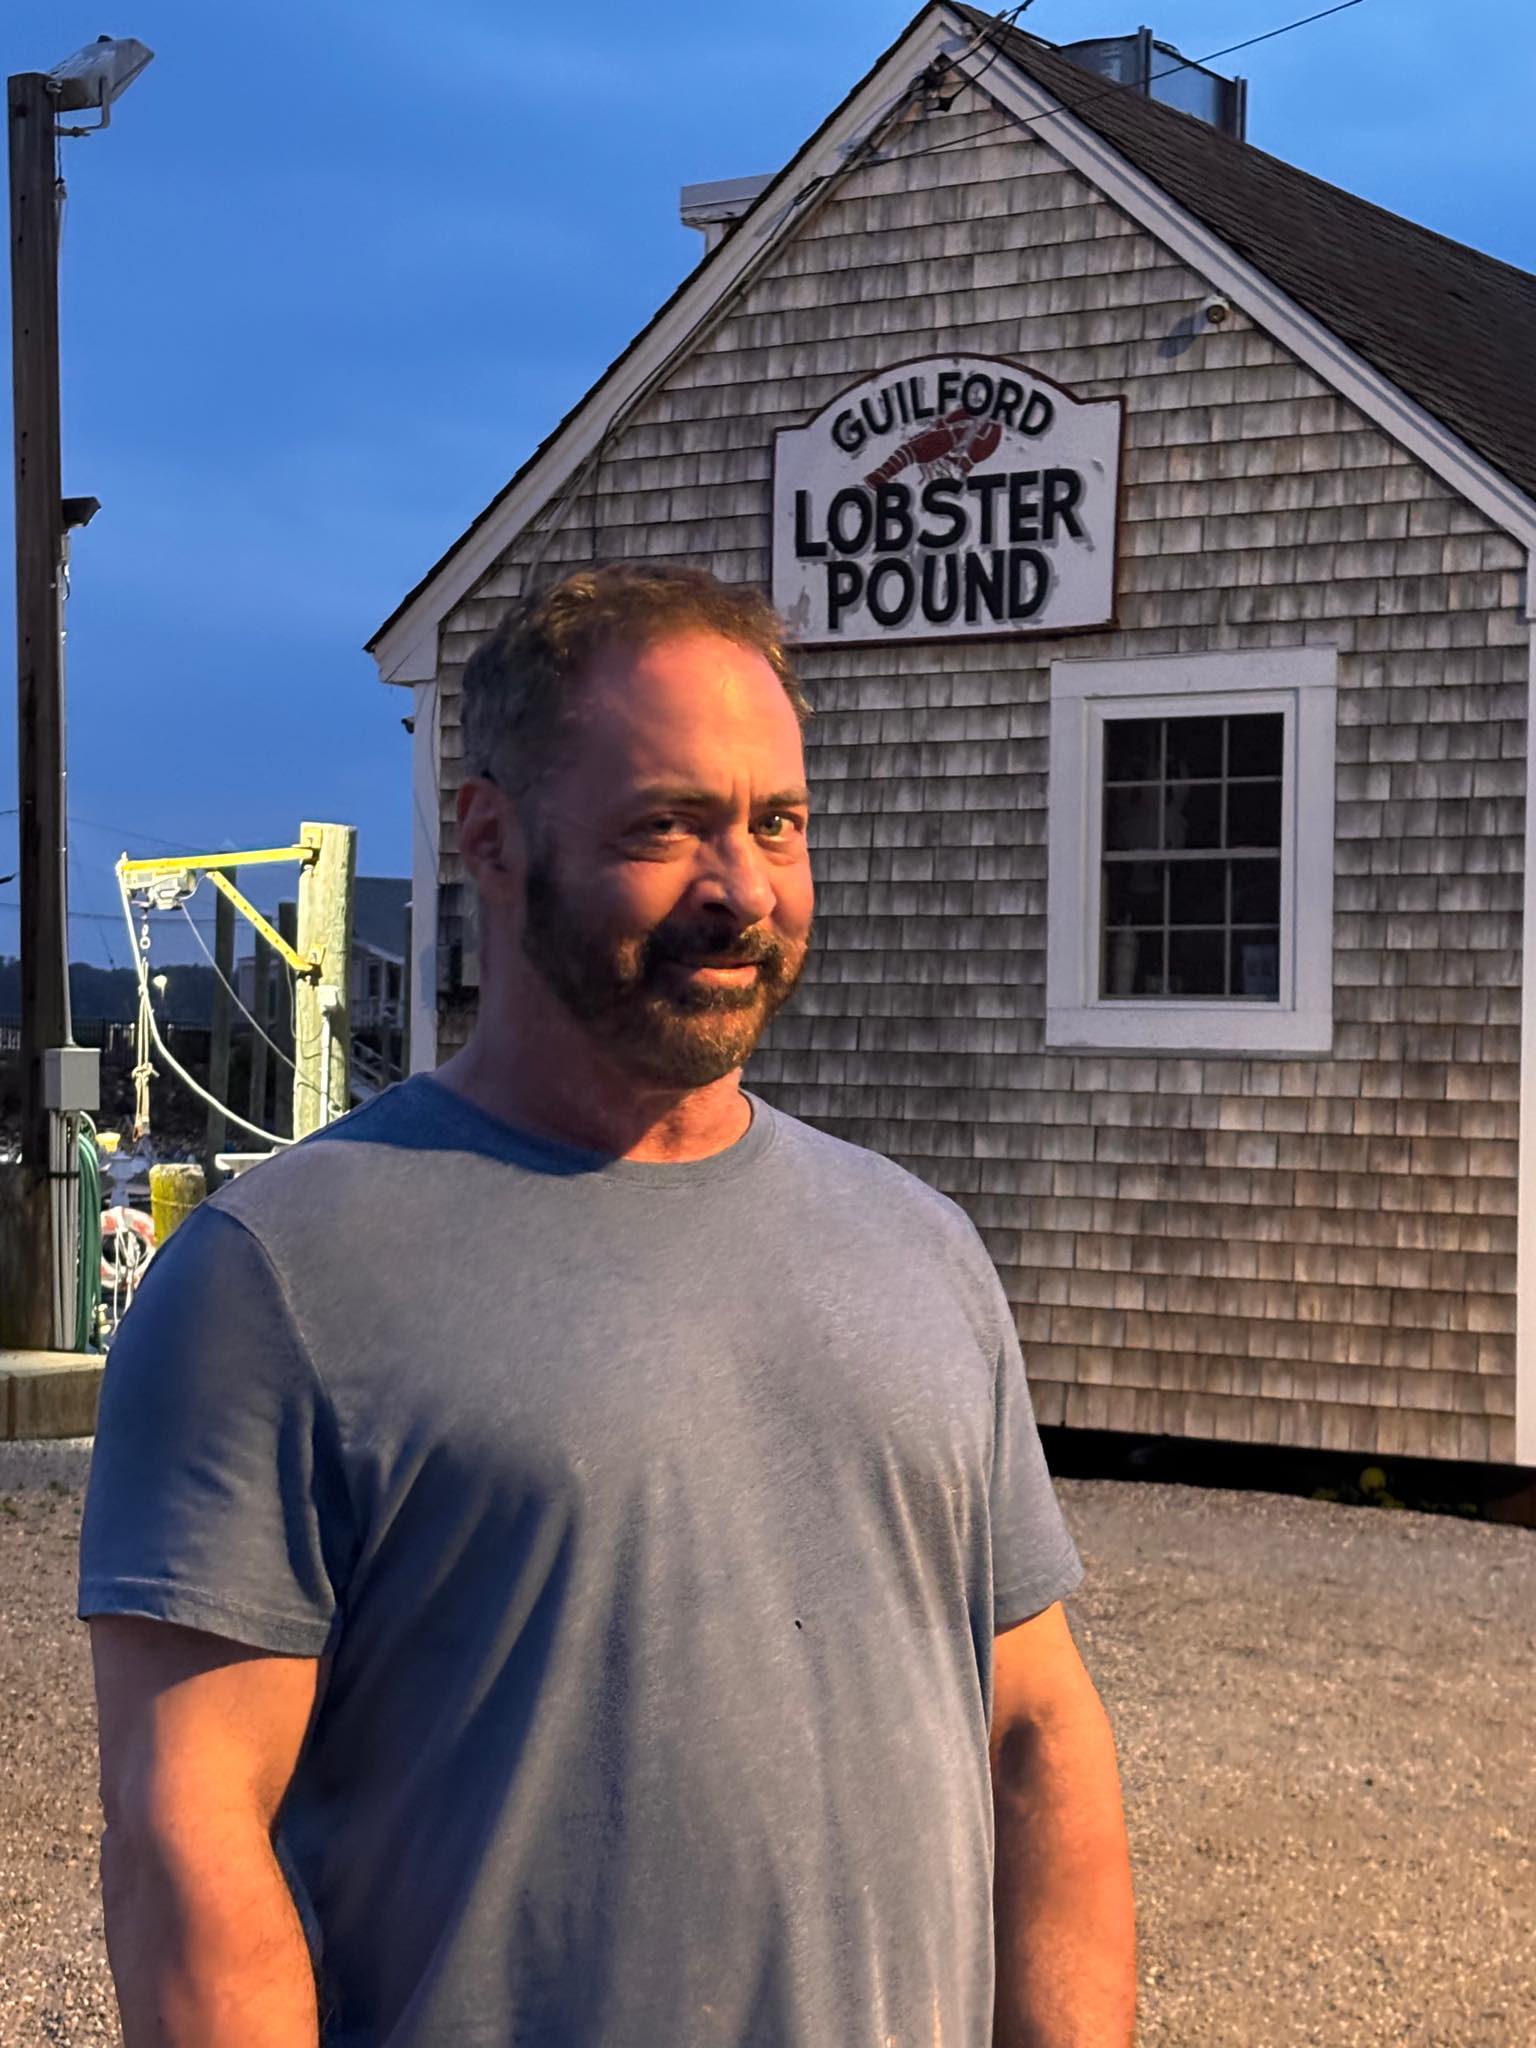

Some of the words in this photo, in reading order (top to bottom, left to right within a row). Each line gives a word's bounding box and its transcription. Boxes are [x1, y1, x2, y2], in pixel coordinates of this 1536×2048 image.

[831, 372, 1055, 452] GUILFORD
[795, 468, 1084, 558] LOBSTER
[827, 548, 1050, 629] POUND
